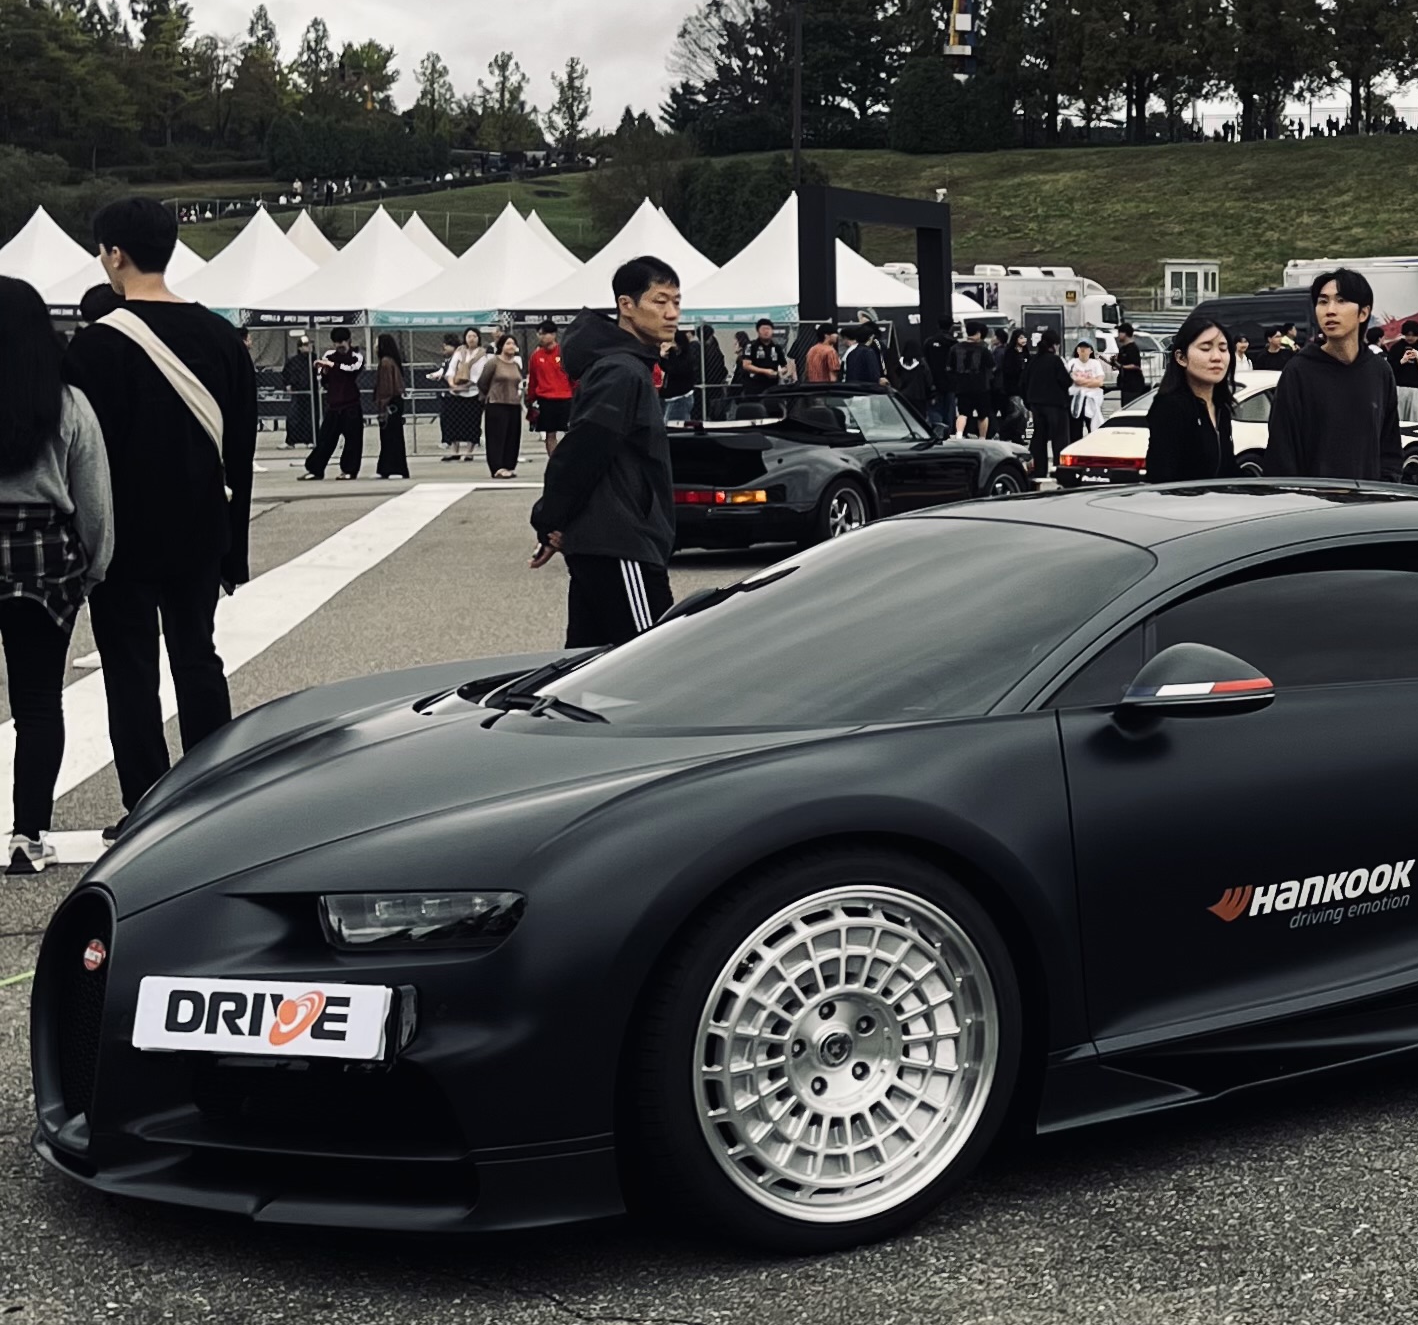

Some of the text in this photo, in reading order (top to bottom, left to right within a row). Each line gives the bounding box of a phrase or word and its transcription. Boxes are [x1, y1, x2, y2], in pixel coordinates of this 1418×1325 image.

[1289, 894, 1411, 929] driving emotion
[165, 989, 351, 1046] DRIVE
